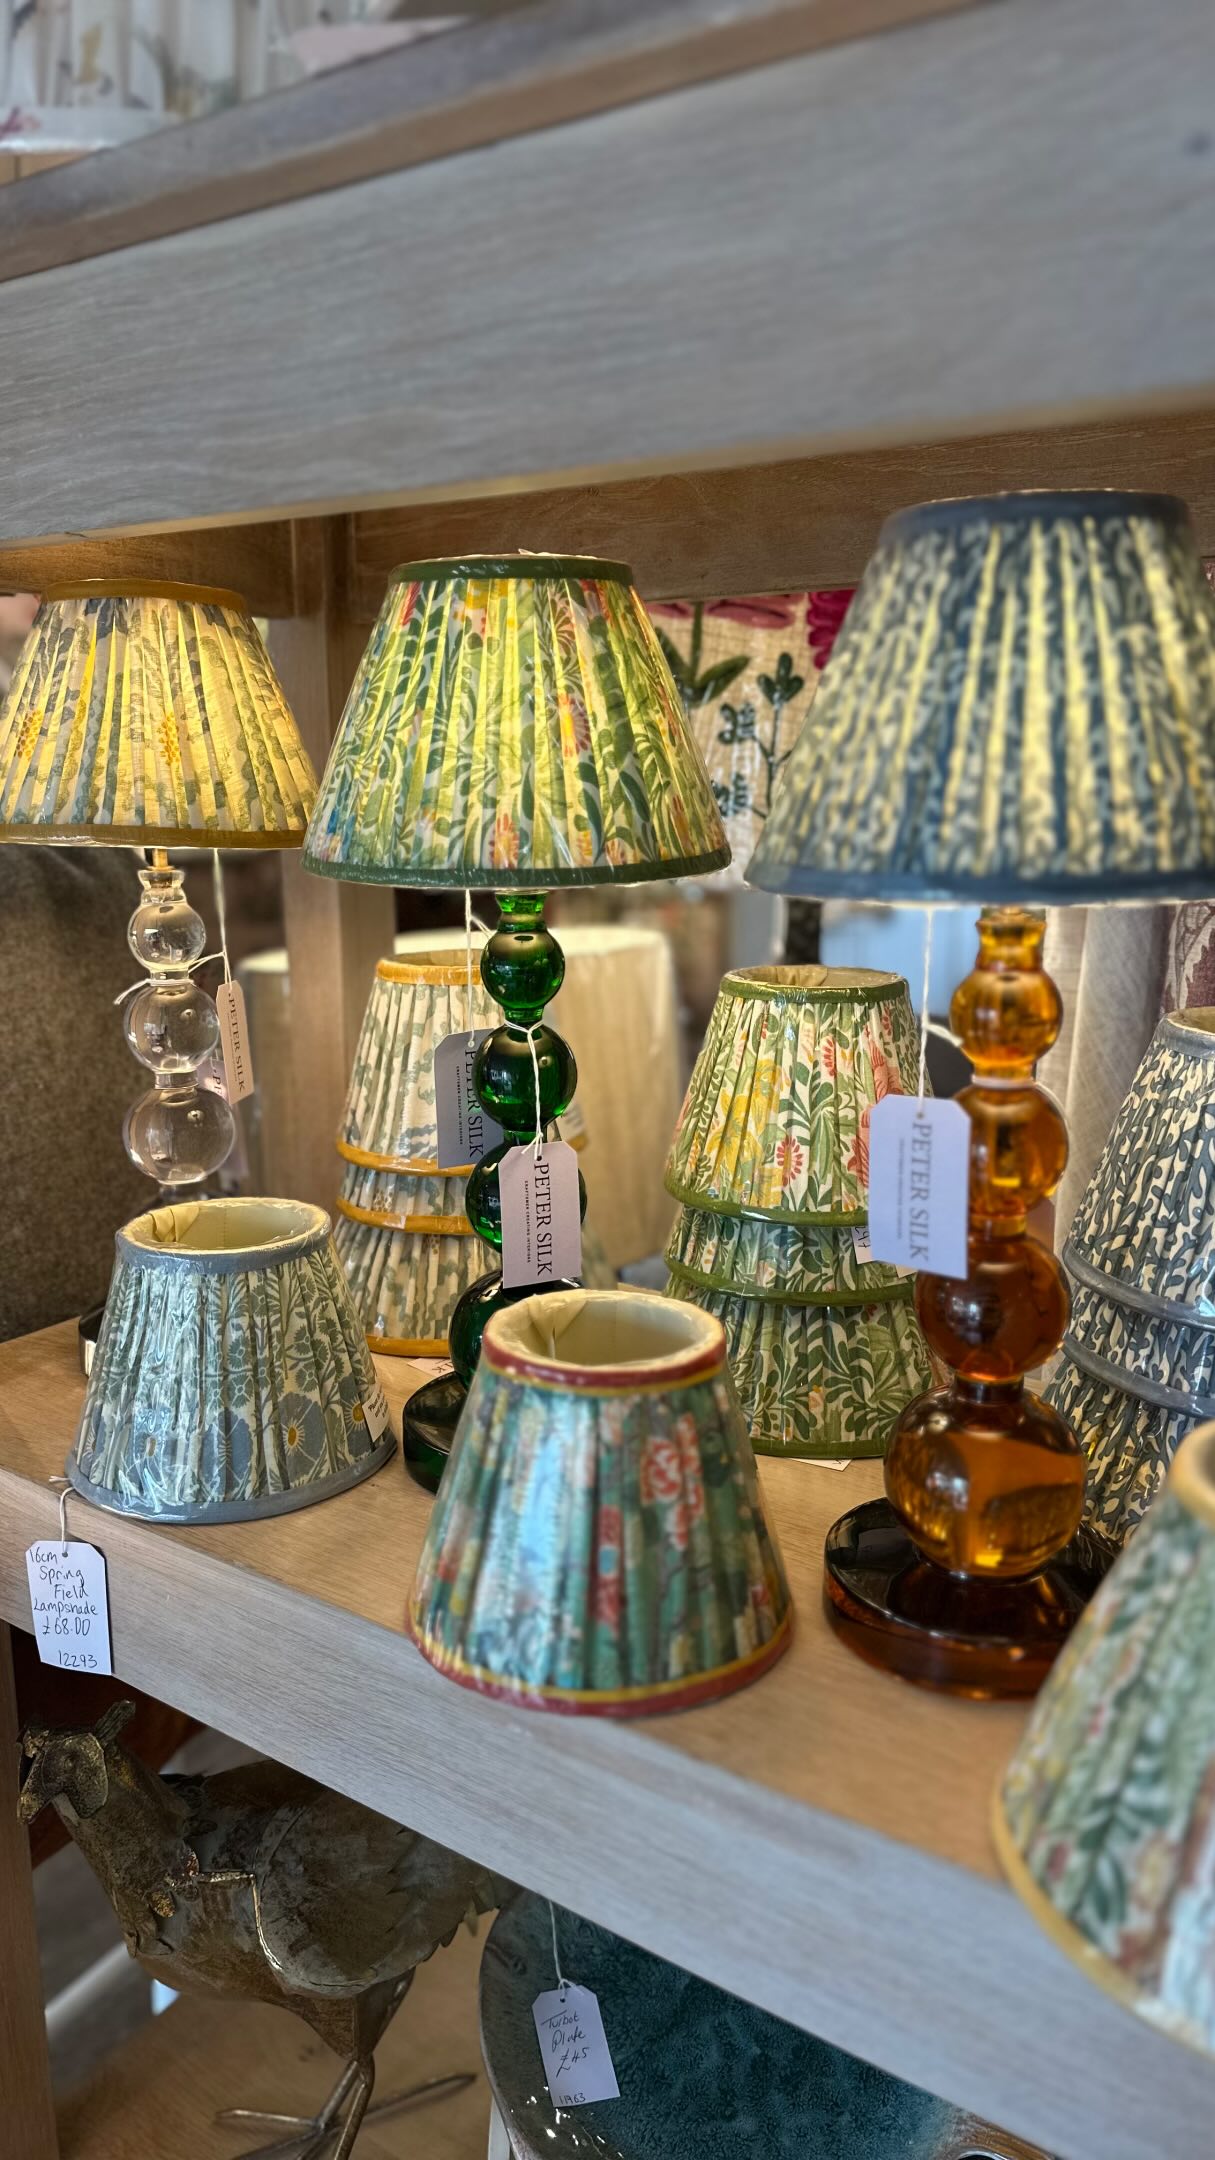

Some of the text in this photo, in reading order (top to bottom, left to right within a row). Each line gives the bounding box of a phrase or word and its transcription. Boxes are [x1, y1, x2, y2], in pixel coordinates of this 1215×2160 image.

[229, 998, 240, 1053] PETER
[236, 1055, 245, 1093] SILK
[467, 1116, 484, 1158] SILK
[909, 1122, 933, 1262] PETER SILK
[533, 1162, 553, 1277] PETER SILK
[29, 1548, 58, 1565] 16cm
[39, 1565, 85, 1588] Spring
[54, 1585, 89, 1600] Field
[58, 1650, 98, 1669] 12293
[541, 2009, 580, 2029] Turbot
[552, 2026, 585, 2053] Plate
[556, 2046, 590, 2078] £45
